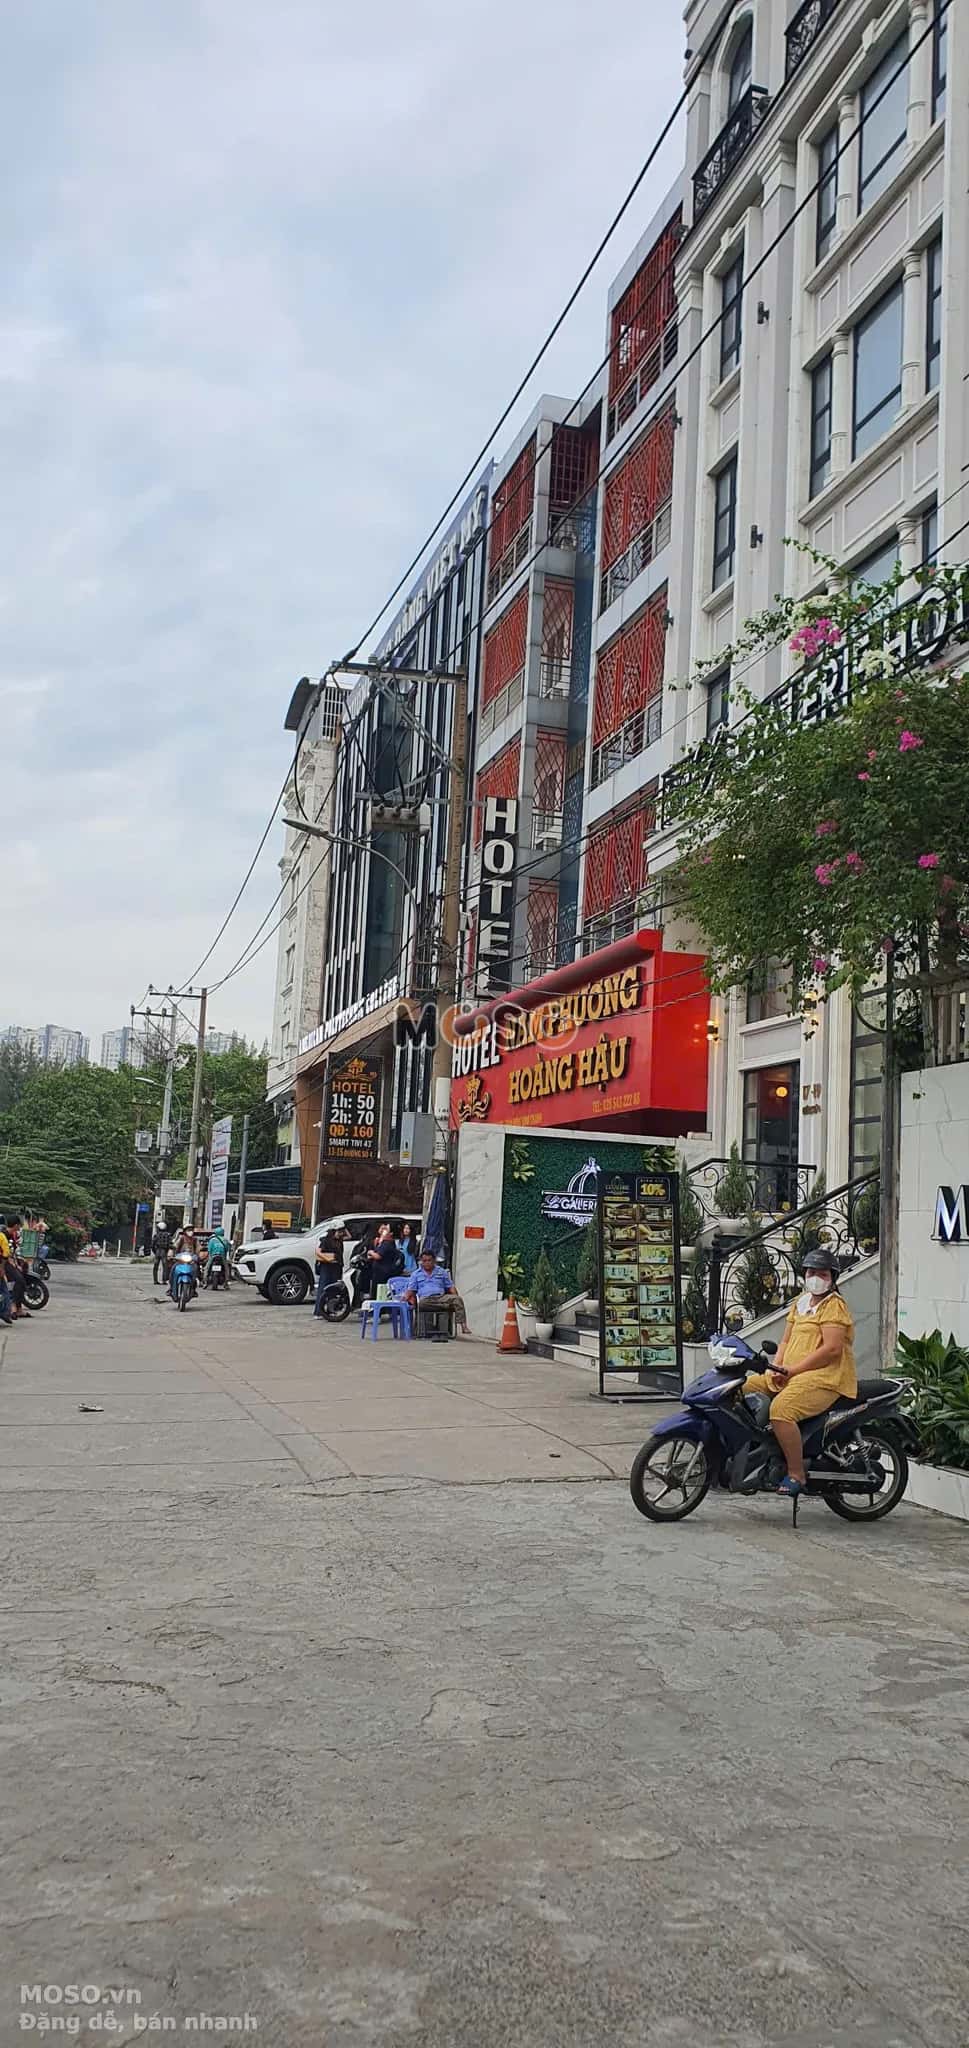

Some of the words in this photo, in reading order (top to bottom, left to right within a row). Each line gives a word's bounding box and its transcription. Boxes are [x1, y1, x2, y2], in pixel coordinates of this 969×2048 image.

[478, 797, 518, 997] HOTEL
[452, 1022, 500, 1078] HOTEL
[508, 1053, 573, 1103] HOÀNG
[577, 1033, 627, 1092] HẬU
[332, 1081, 375, 1094] HOTEL
[331, 1093, 352, 1108] 1h:
[357, 1094, 374, 1110] 50
[330, 1108, 352, 1124] 2h:
[357, 1110, 374, 1126] 70
[352, 1125, 374, 1138] 160
[640, 1183, 666, 1196] 10%
